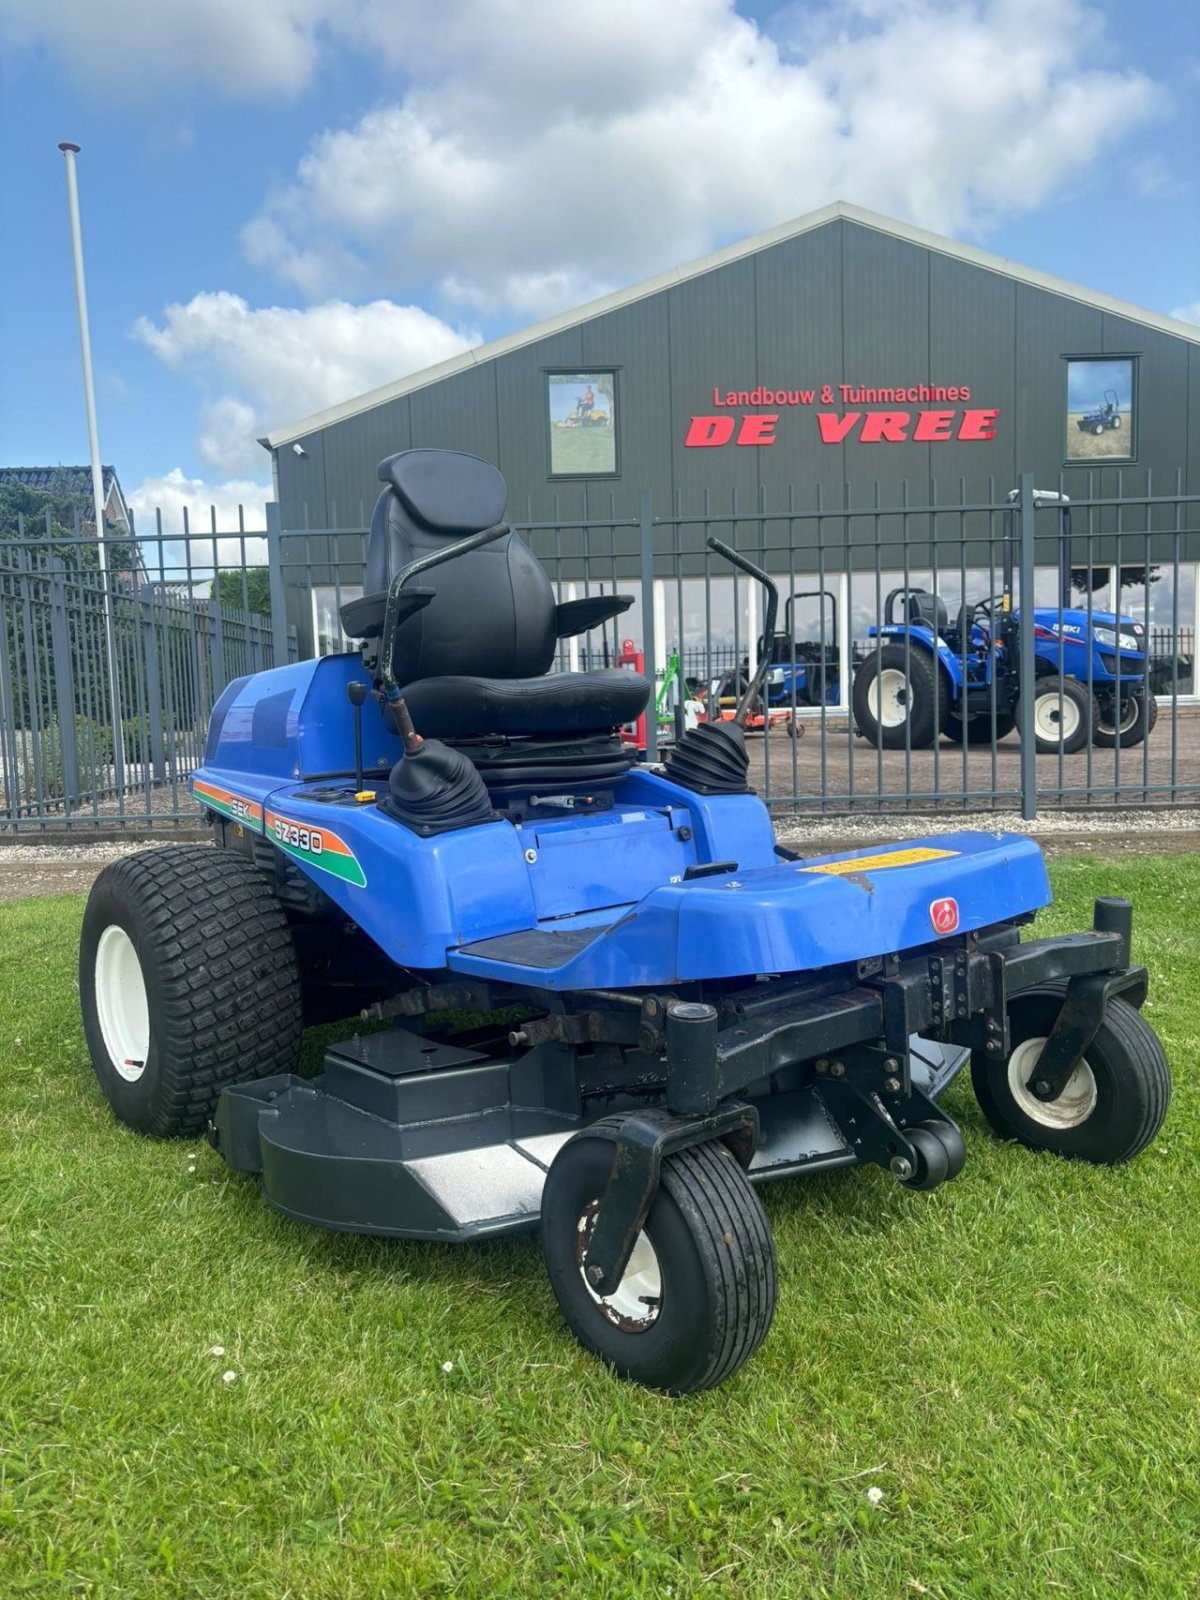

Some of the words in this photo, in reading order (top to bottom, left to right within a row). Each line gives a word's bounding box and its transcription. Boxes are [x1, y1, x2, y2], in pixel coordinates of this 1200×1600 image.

[713, 386, 815, 407] Landbouw
[820, 384, 834, 405] &
[838, 383, 971, 404] Tuinmachines
[684, 414, 779, 447] DE
[816, 409, 1000, 444] VREE
[274, 818, 323, 855] SZ330
